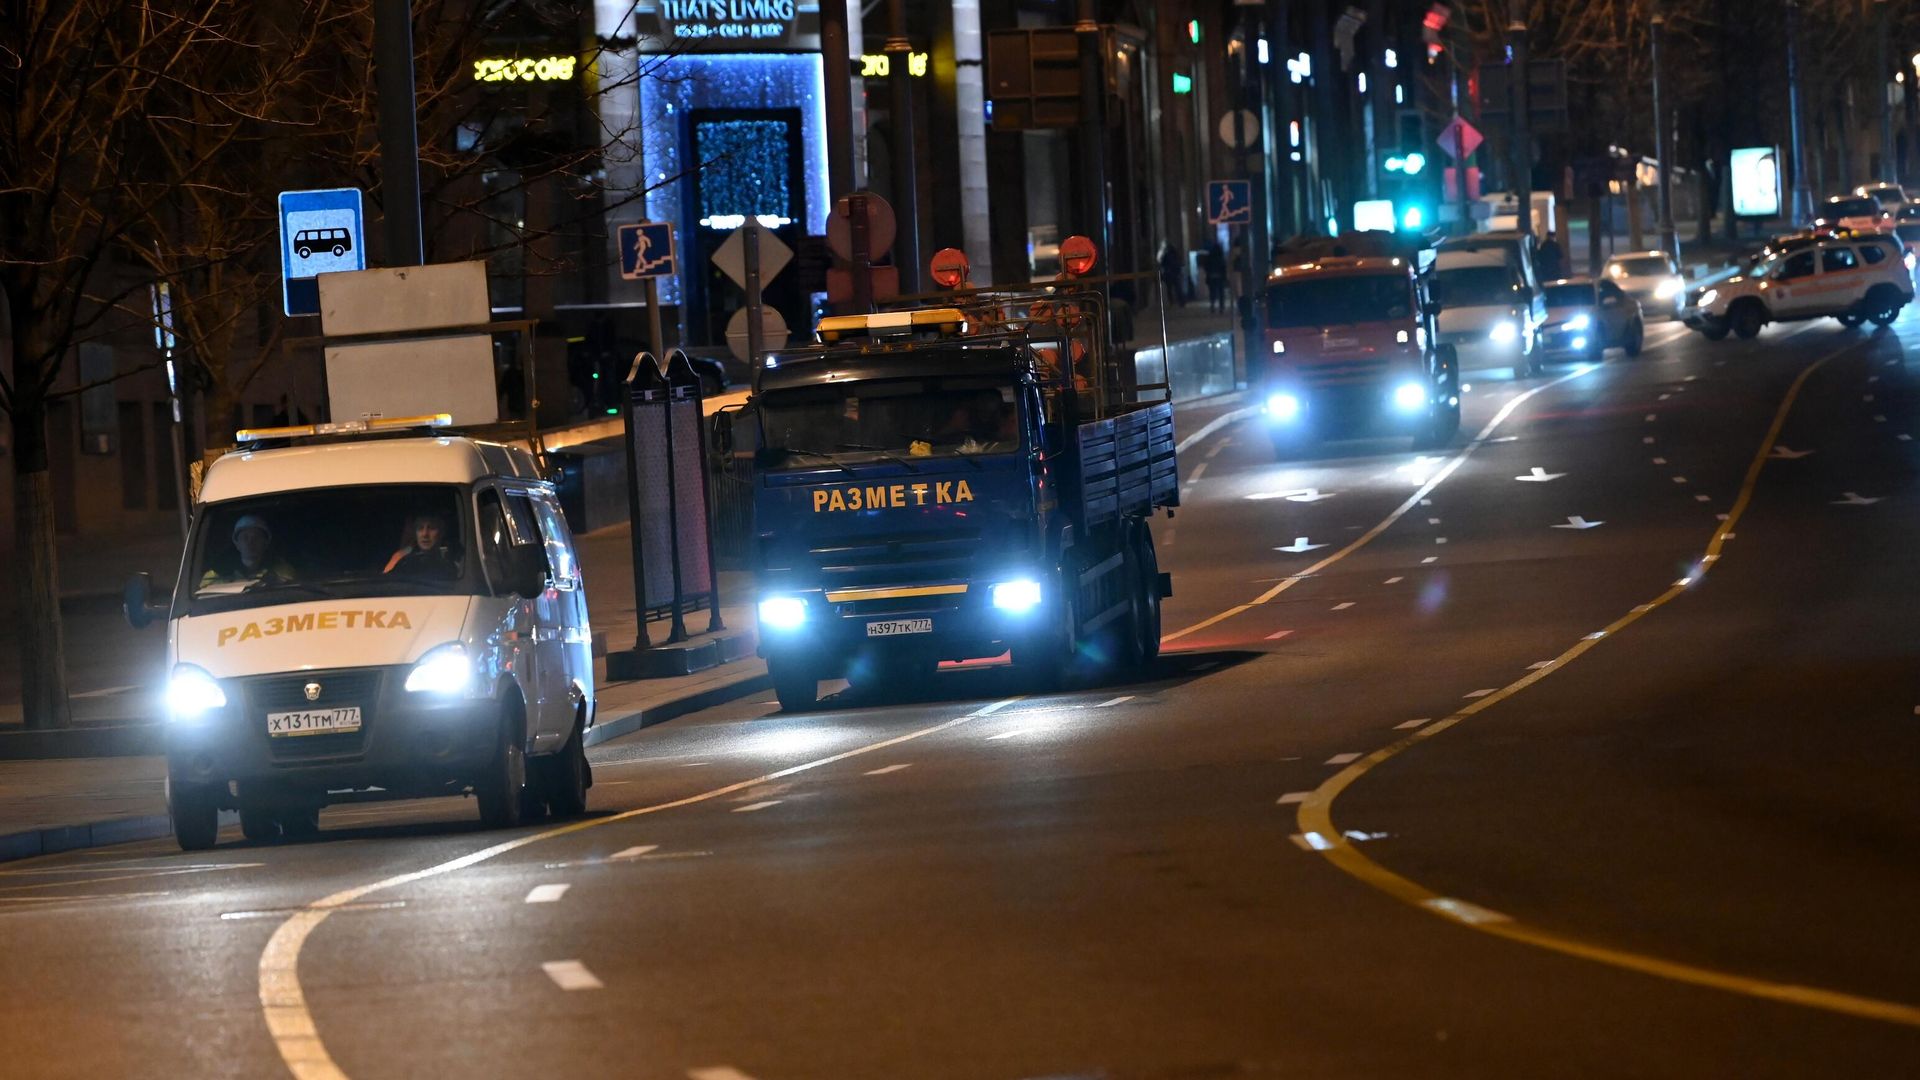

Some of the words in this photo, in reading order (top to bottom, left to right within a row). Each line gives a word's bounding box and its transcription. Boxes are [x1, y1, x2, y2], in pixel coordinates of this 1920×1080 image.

[731, 0, 795, 20] LIVING
[813, 480, 974, 512] РАЗМЕТКА
[217, 611, 411, 647] РАЗМЕТКА
